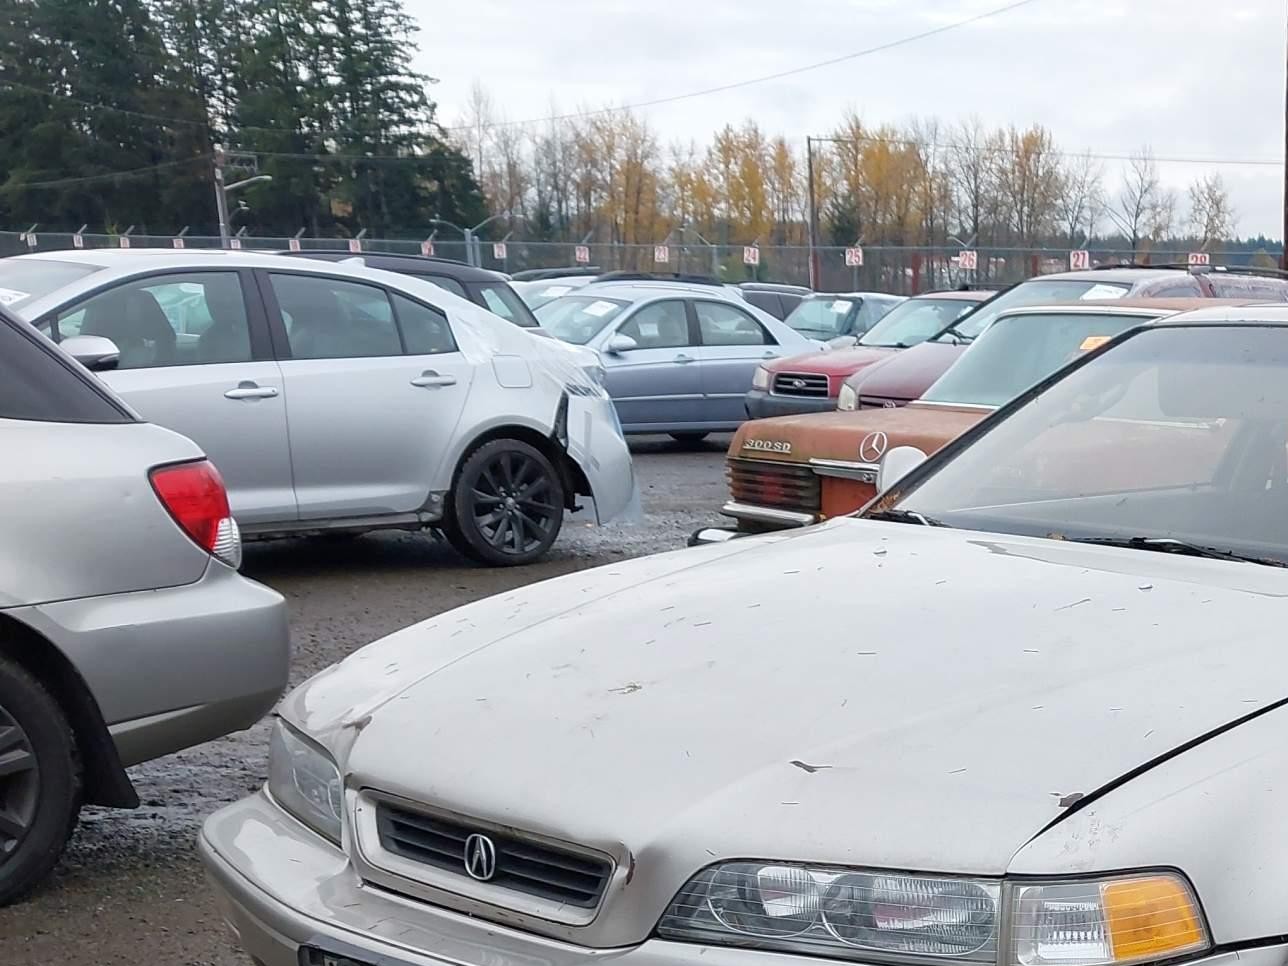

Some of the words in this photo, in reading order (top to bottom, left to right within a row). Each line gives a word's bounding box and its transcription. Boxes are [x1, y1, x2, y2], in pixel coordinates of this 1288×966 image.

[745, 247, 758, 263] 24
[847, 249, 861, 264] 25
[960, 252, 975, 267] 26
[1072, 252, 1086, 268] 27
